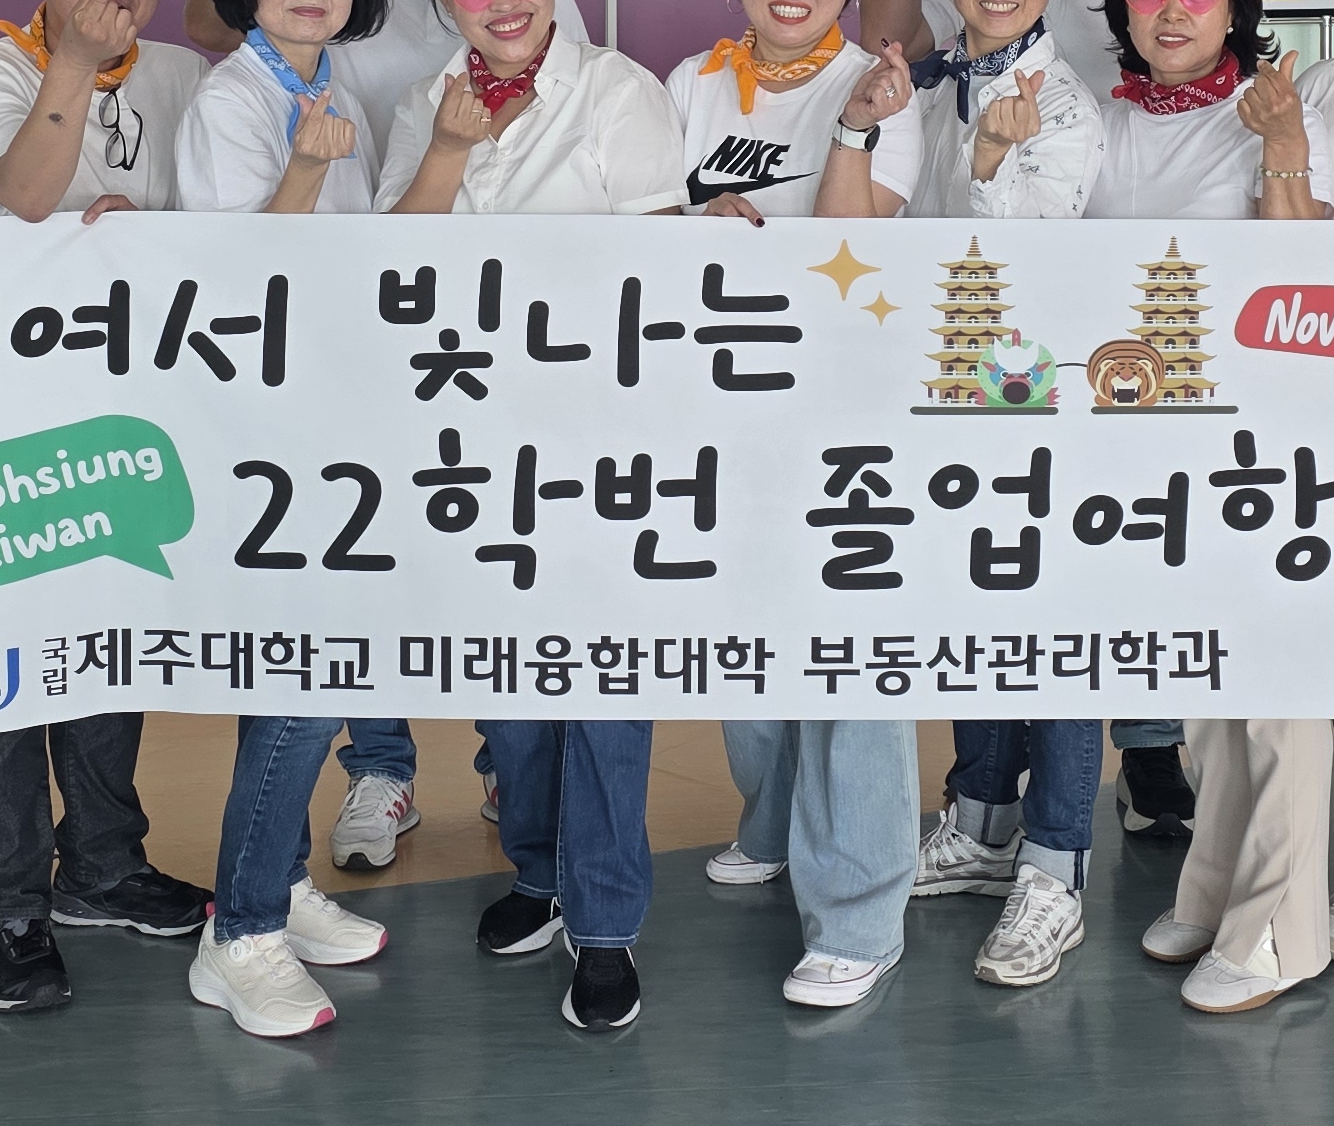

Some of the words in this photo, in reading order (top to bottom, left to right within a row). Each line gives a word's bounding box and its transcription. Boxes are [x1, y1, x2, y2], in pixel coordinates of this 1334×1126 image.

[706, 134, 790, 180] NIKE
[378, 258, 804, 402] 빛나는
[232, 427, 718, 591] 22학번
[42, 636, 71, 697] 국립
[73, 626, 375, 692] 제주대학교
[399, 632, 775, 697] 미래융합대학
[802, 627, 1230, 697] 부동산관리학과
